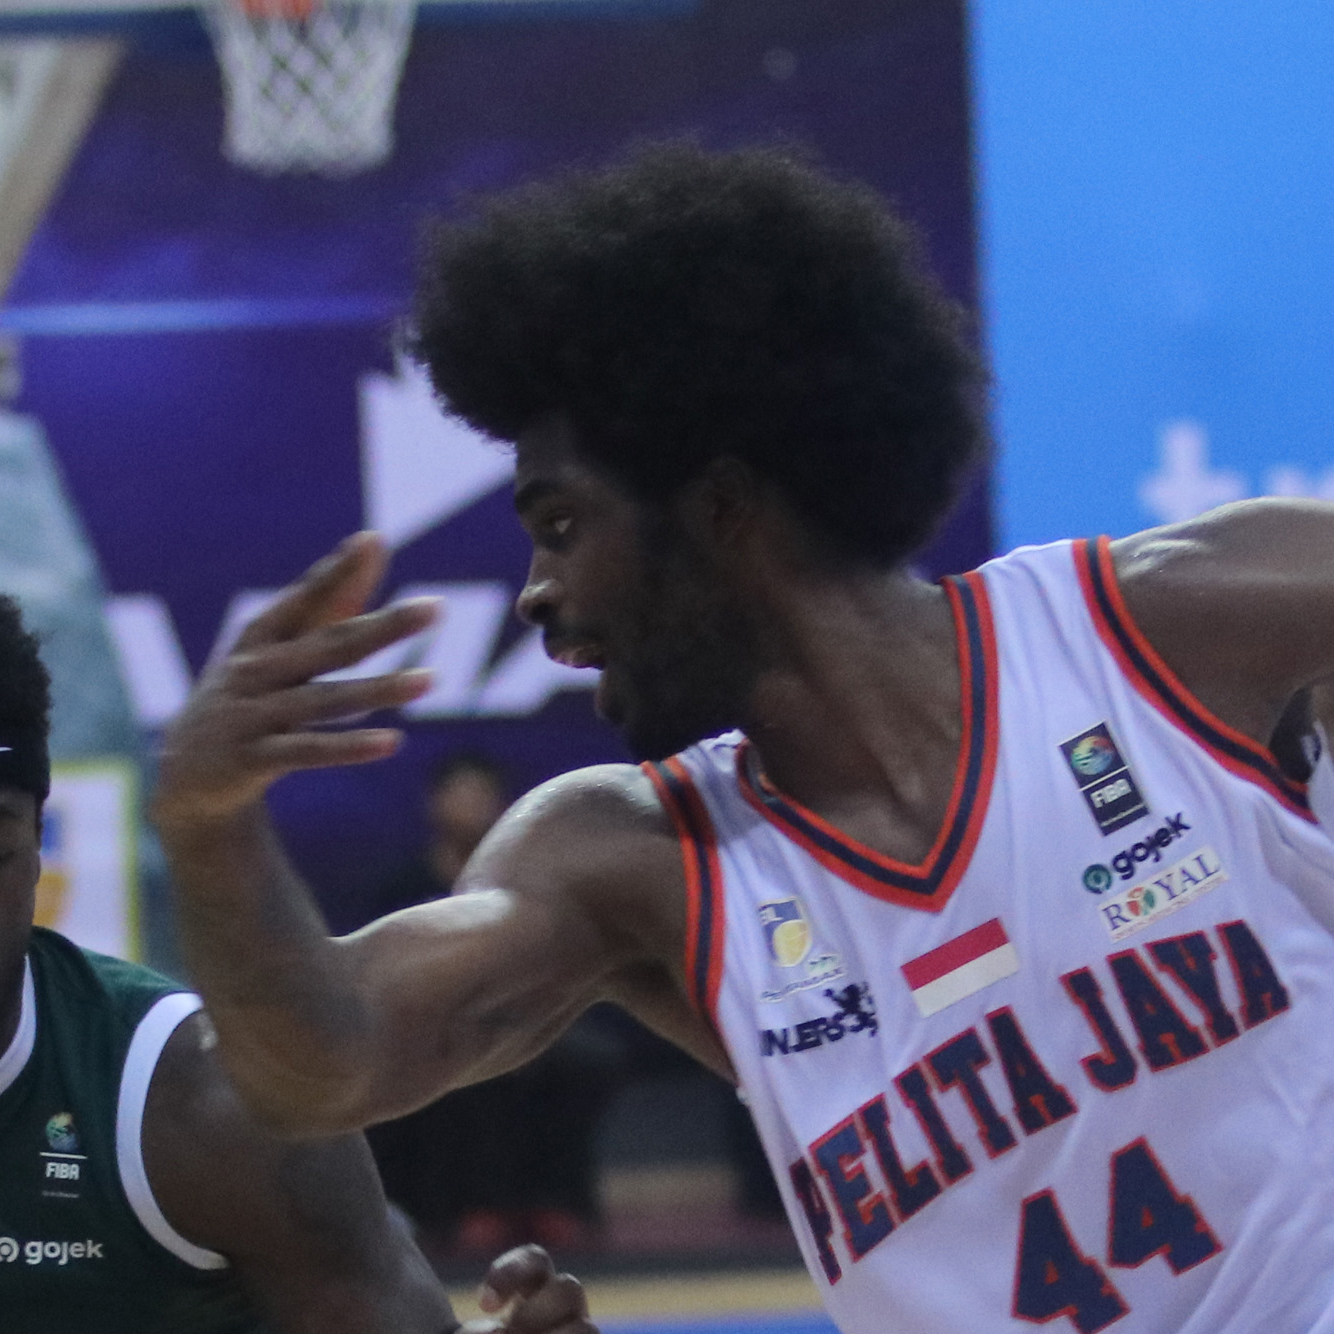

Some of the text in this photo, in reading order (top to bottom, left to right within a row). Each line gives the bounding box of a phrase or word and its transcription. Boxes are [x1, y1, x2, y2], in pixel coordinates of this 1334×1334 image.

[1111, 811, 1192, 881] gojek
[788, 918, 1292, 1286] PELITA JAYA
[45, 1161, 81, 1181] FIBA
[23, 1239, 105, 1266] gojek
